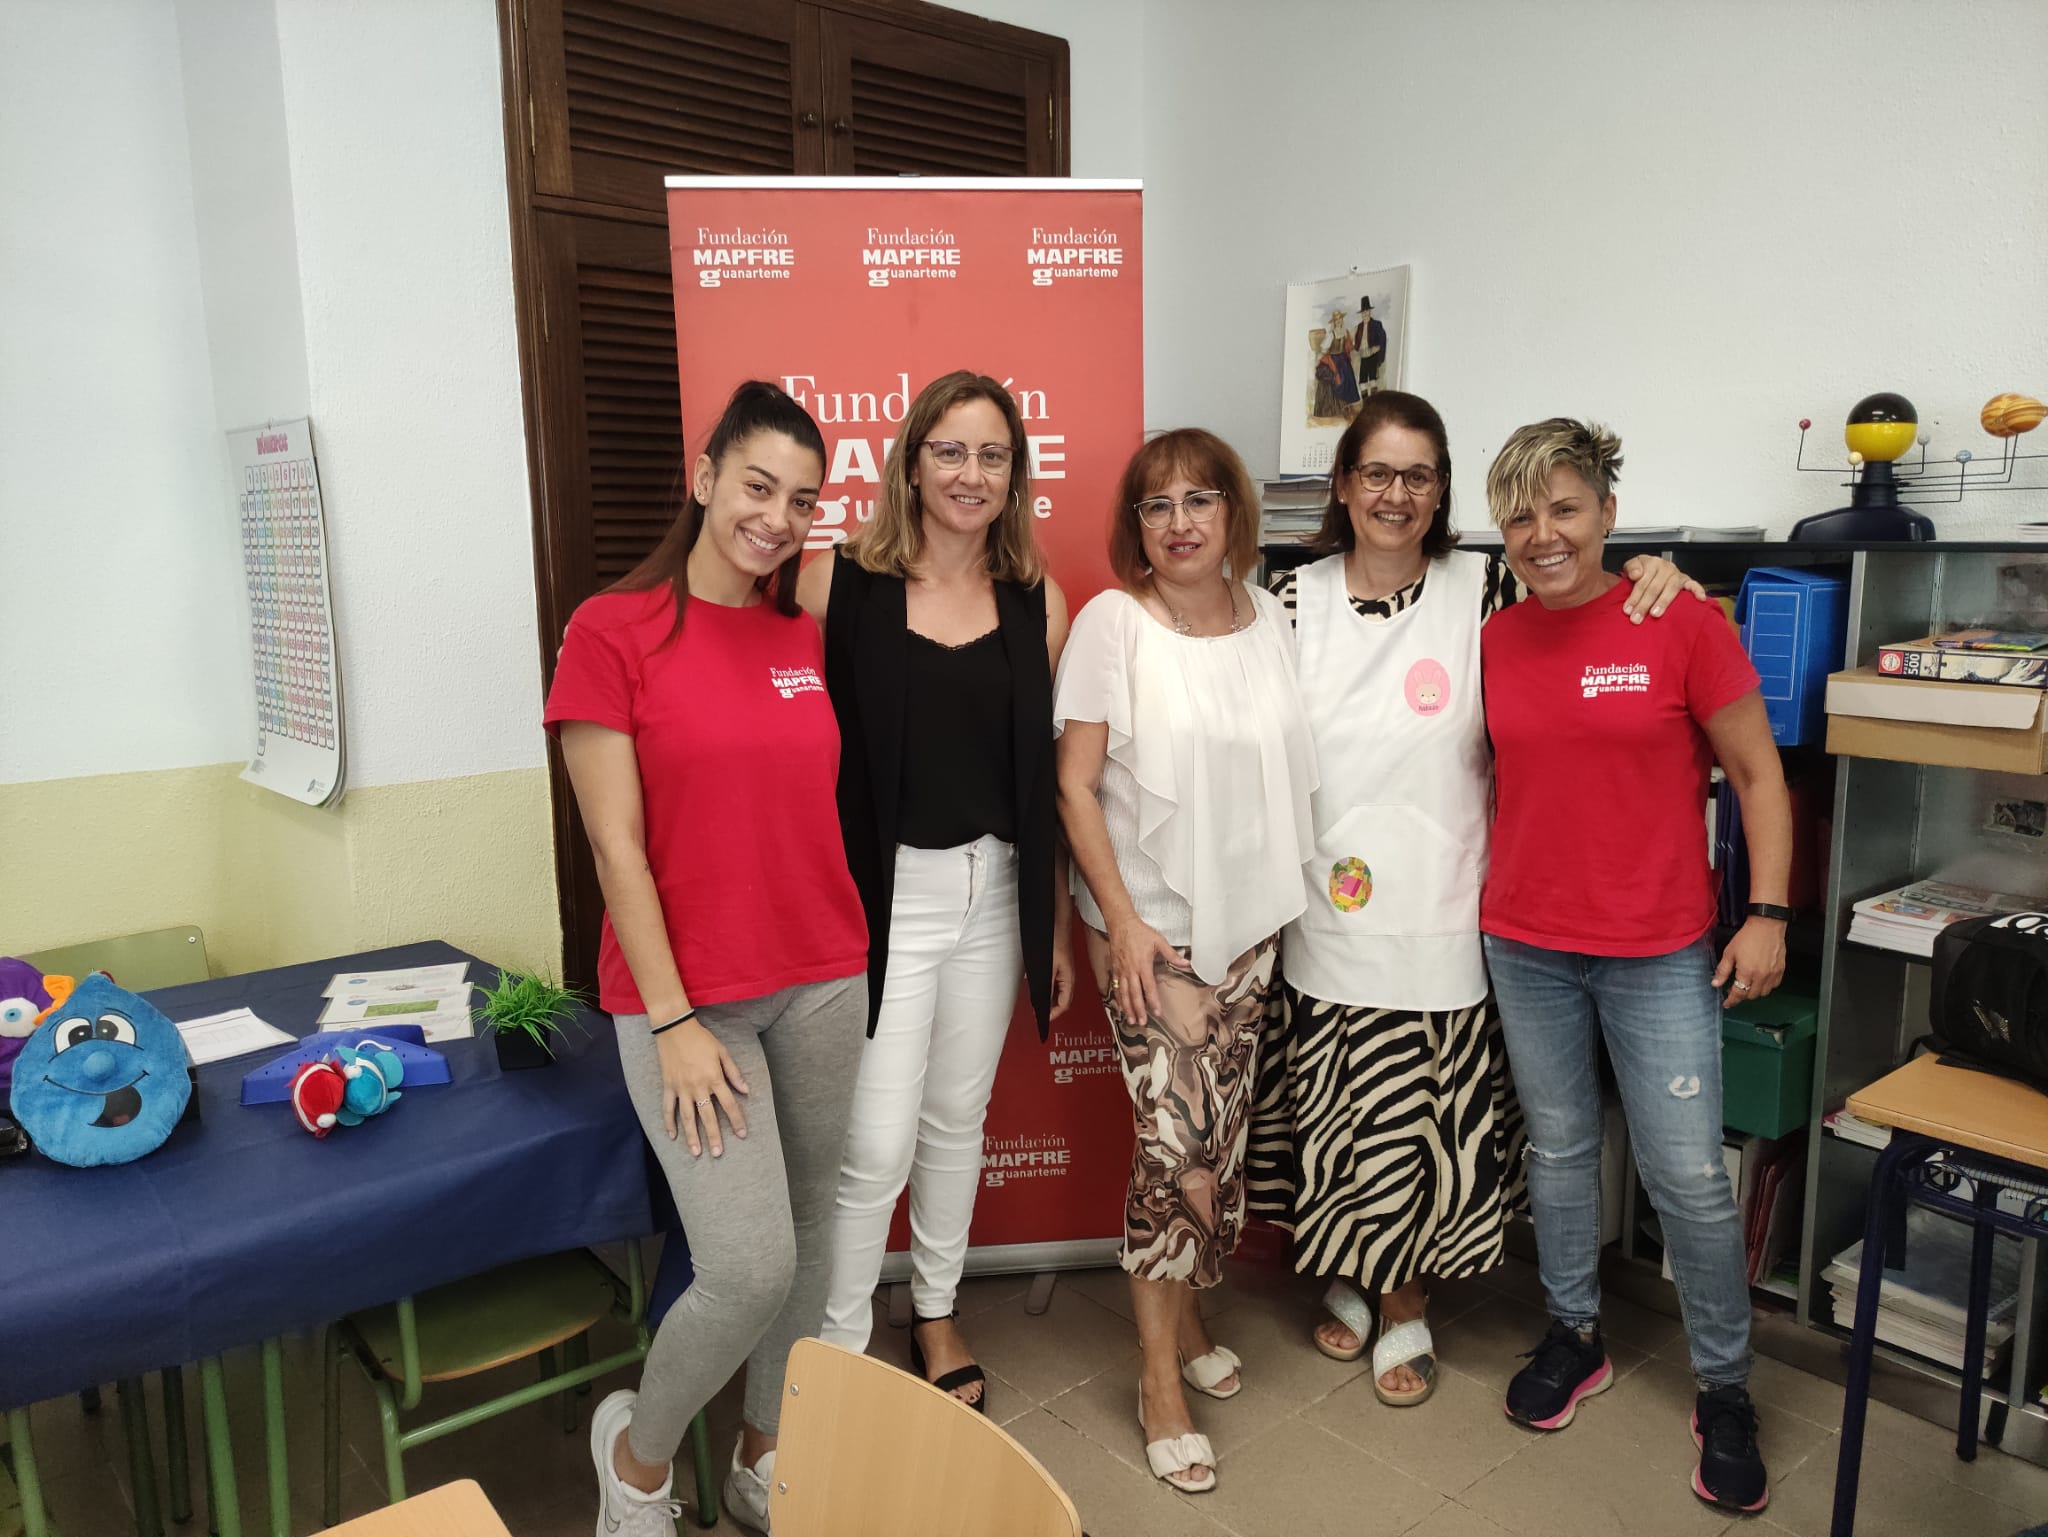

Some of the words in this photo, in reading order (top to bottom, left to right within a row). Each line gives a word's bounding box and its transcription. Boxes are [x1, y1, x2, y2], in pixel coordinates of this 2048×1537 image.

[697, 227, 788, 245] Fundación
[867, 227, 955, 245] Fundación
[1032, 227, 1118, 245] Fundación
[693, 249, 795, 265] MAPFRE
[862, 249, 961, 265] MAPFRE
[1027, 248, 1123, 265] MAPFRE
[699, 268, 790, 288] guanarteme
[868, 267, 957, 287] guanarteme
[1032, 267, 1119, 286] guanarteme
[780, 373, 1050, 423] Fundn
[1585, 662, 1647, 676] Fundación
[1908, 653, 1920, 675] 500
[771, 676, 823, 688] MAPFRE
[1581, 674, 1650, 687] MAPFRE
[1583, 685, 1647, 698] guanarteme
[1054, 1030, 1116, 1047] Fundaci
[1049, 1048, 1118, 1065] MAPF
[1054, 1064, 1122, 1084] guanarte
[985, 1133, 1065, 1151] Fundación
[981, 1150, 1071, 1168] MAPFRE
[985, 1168, 1067, 1188] guanarteme
